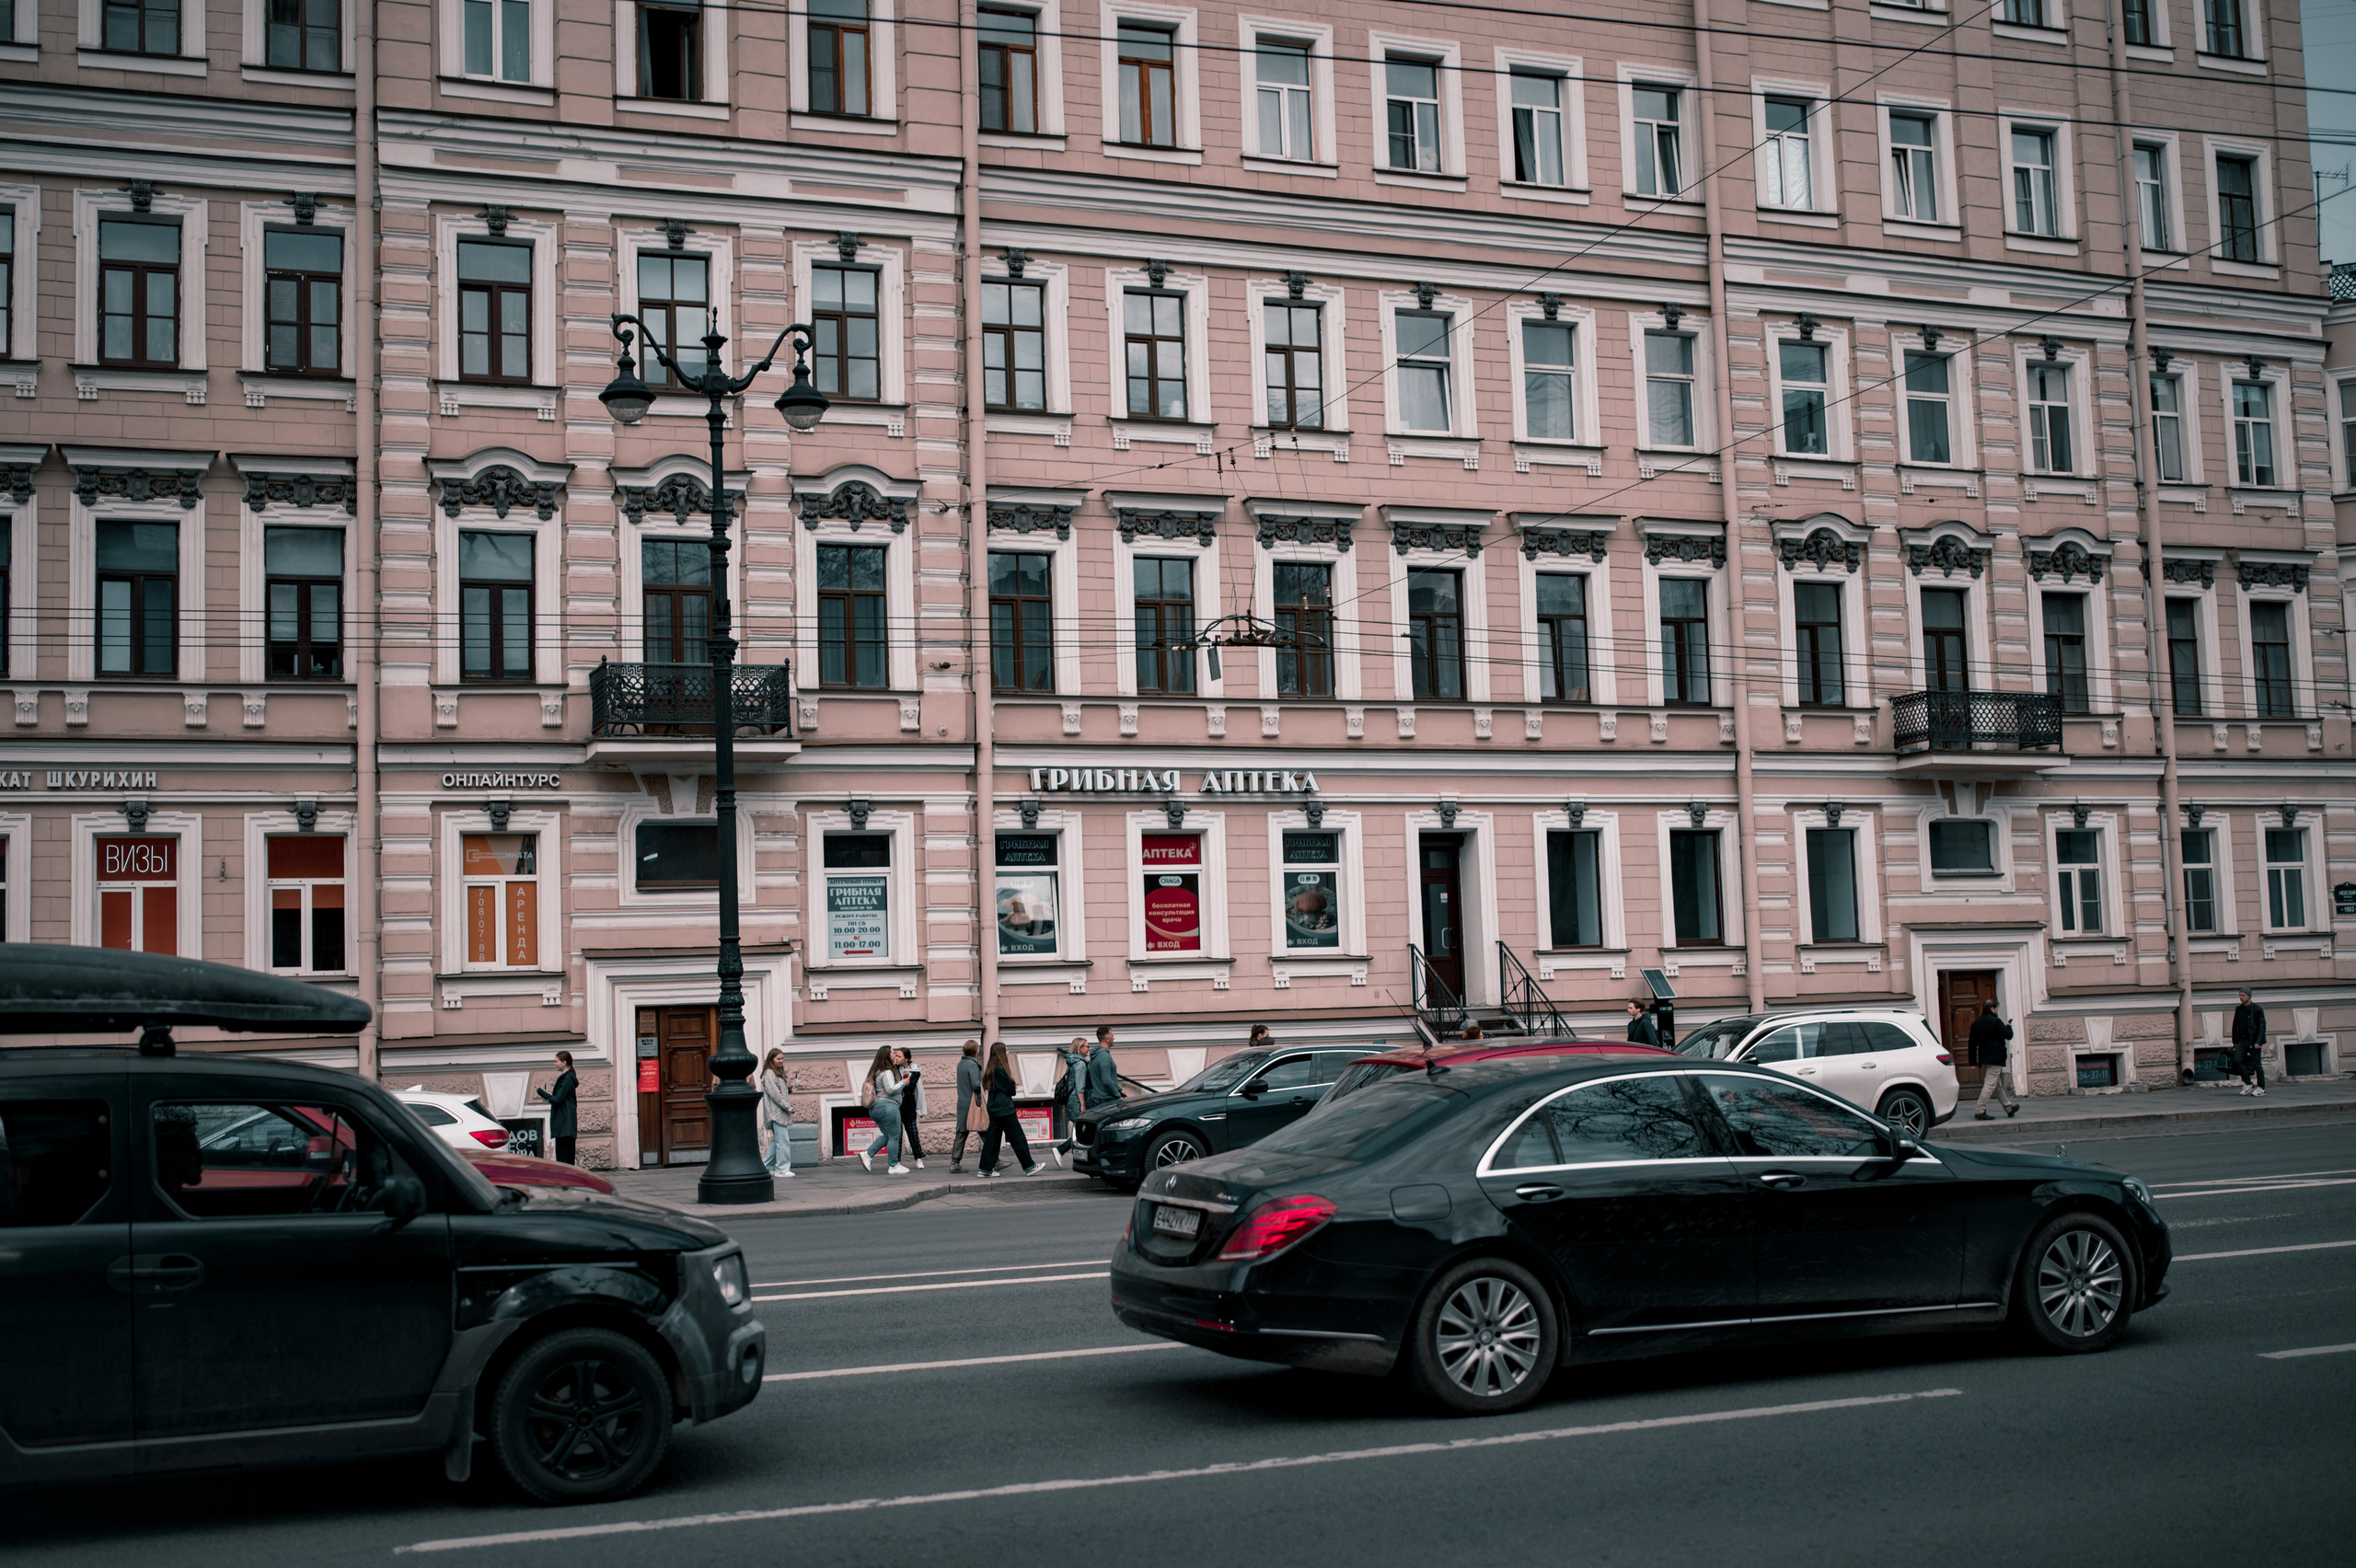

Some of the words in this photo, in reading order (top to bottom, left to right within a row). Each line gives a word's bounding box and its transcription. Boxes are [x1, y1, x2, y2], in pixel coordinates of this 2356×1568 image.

[47, 771, 156, 788] ШКУРИХИН
[442, 771, 560, 787] ОНЛАЙНТУРС
[1030, 768, 1181, 791] ГРИБНАЯ
[1200, 770, 1321, 792] АПТЕКА
[999, 839, 1049, 849] ГРИБНАЯ
[1286, 838, 1331, 847] ГРИБНАЯ
[1004, 852, 1045, 861] АПТЕКА
[1142, 848, 1193, 859] АПТЕКА
[1289, 850, 1327, 859] АПТЕКА
[106, 845, 167, 873] ВИЗЫ
[829, 887, 882, 896] ГРИБНАЯ
[835, 896, 878, 905] АПТЕКА
[516, 887, 526, 960] АРЕНДА
[834, 940, 881, 949] 11.00-17.00
[2077, 1070, 2108, 1079] 34-37-11
